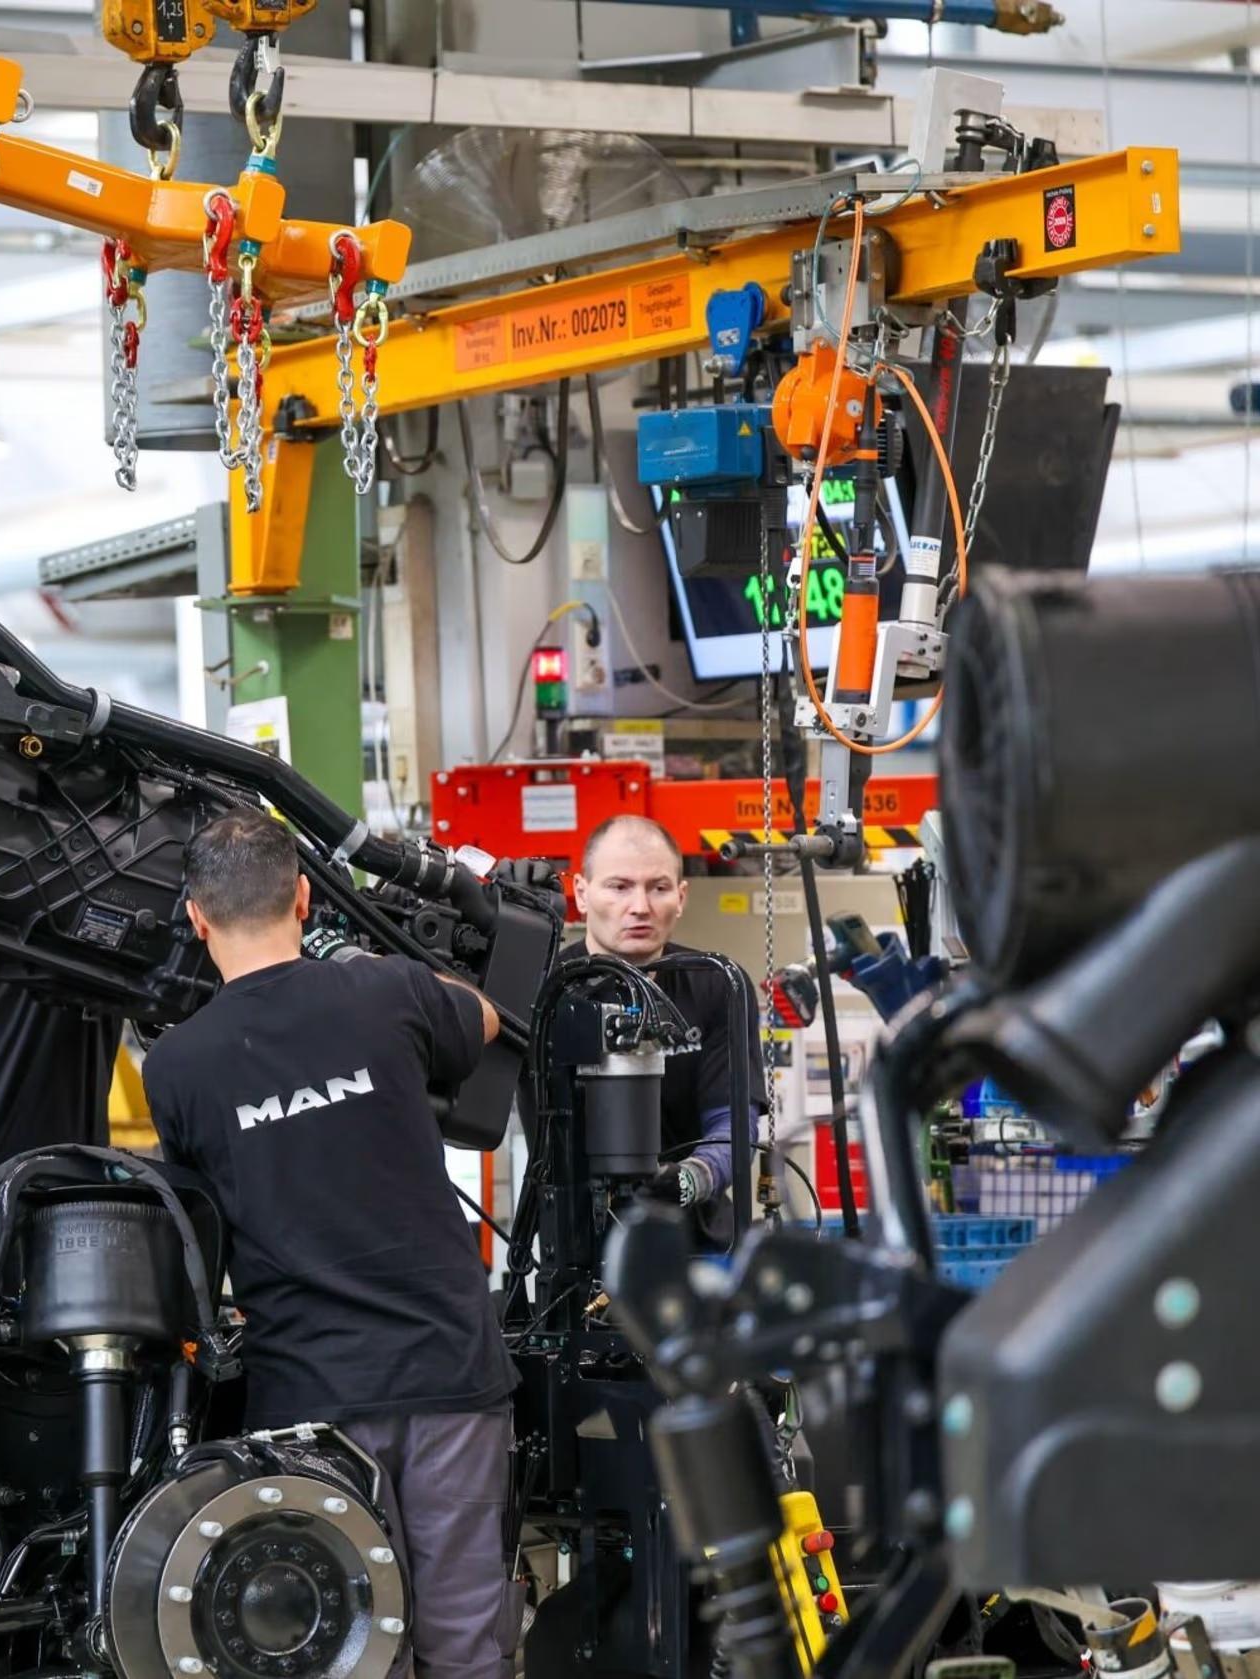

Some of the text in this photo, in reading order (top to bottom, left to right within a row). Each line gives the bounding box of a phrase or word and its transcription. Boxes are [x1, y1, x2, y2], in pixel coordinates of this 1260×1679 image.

[512, 315, 567, 350] Inv.Nr.:
[571, 299, 627, 337] 002079
[236, 1067, 374, 1130] MAN
